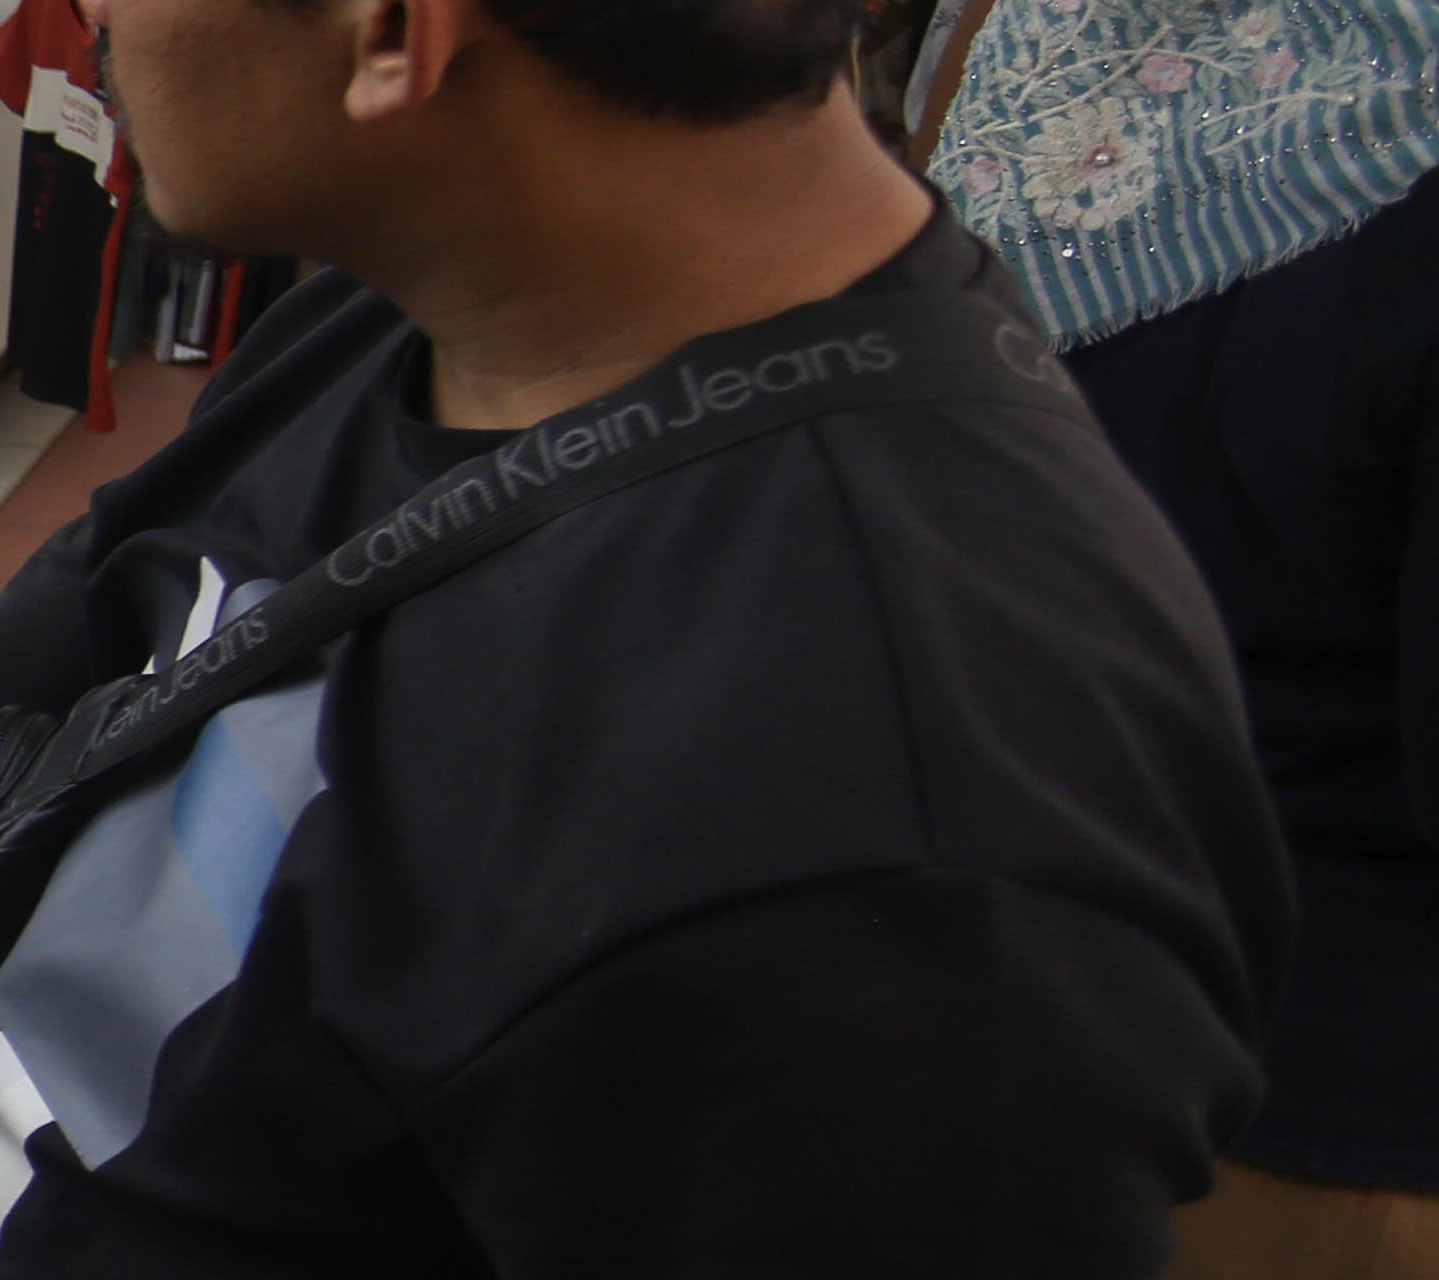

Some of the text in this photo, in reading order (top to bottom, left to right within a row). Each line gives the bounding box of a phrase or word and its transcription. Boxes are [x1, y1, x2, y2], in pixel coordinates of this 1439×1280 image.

[326, 476, 499, 587] Calvin
[494, 400, 663, 501] Klein
[667, 330, 899, 429] Jeans
[158, 606, 271, 705] Jeans
